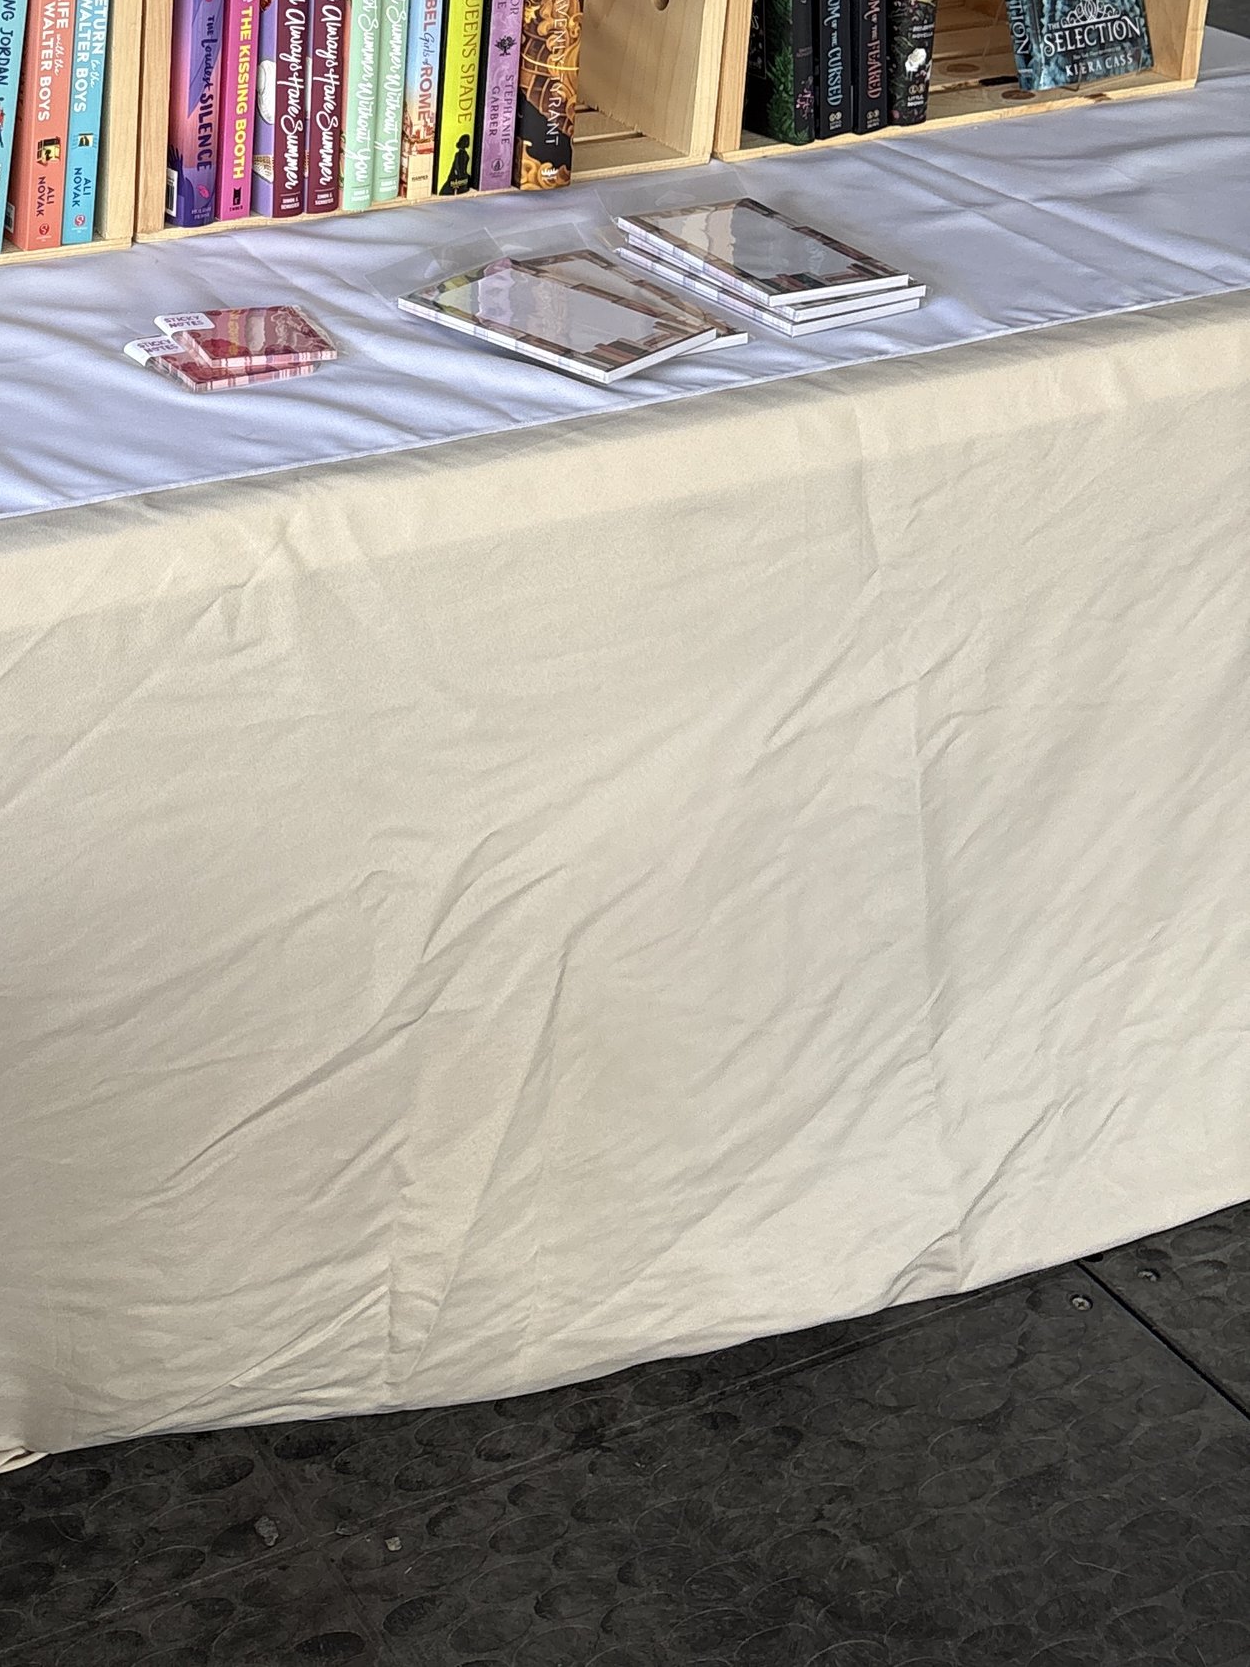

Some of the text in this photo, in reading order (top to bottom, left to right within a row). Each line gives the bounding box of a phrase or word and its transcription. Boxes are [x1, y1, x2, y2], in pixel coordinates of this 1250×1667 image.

[1043, 16, 1141, 57] SELECTION
[1048, 21, 1061, 31] THE
[38, 1, 56, 122] WALTER BOYS
[1065, 52, 1134, 77] KIERA CASS
[73, 67, 88, 113] BOYS
[232, 6, 254, 179] THE KISSING BOOTH
[457, 61, 476, 124] SPADE
[500, 74, 515, 145] STEPHANIE
[488, 86, 500, 137] GARBER
[36, 176, 46, 217] NOVAK
[47, 186, 55, 204] ALI
[71, 167, 83, 208] NOVAK
[84, 178, 92, 196] ALI
[163, 315, 200, 323] STICKY
[168, 320, 204, 328] NOTES
[137, 339, 172, 349] STICKY
[143, 344, 178, 354] NOTES
